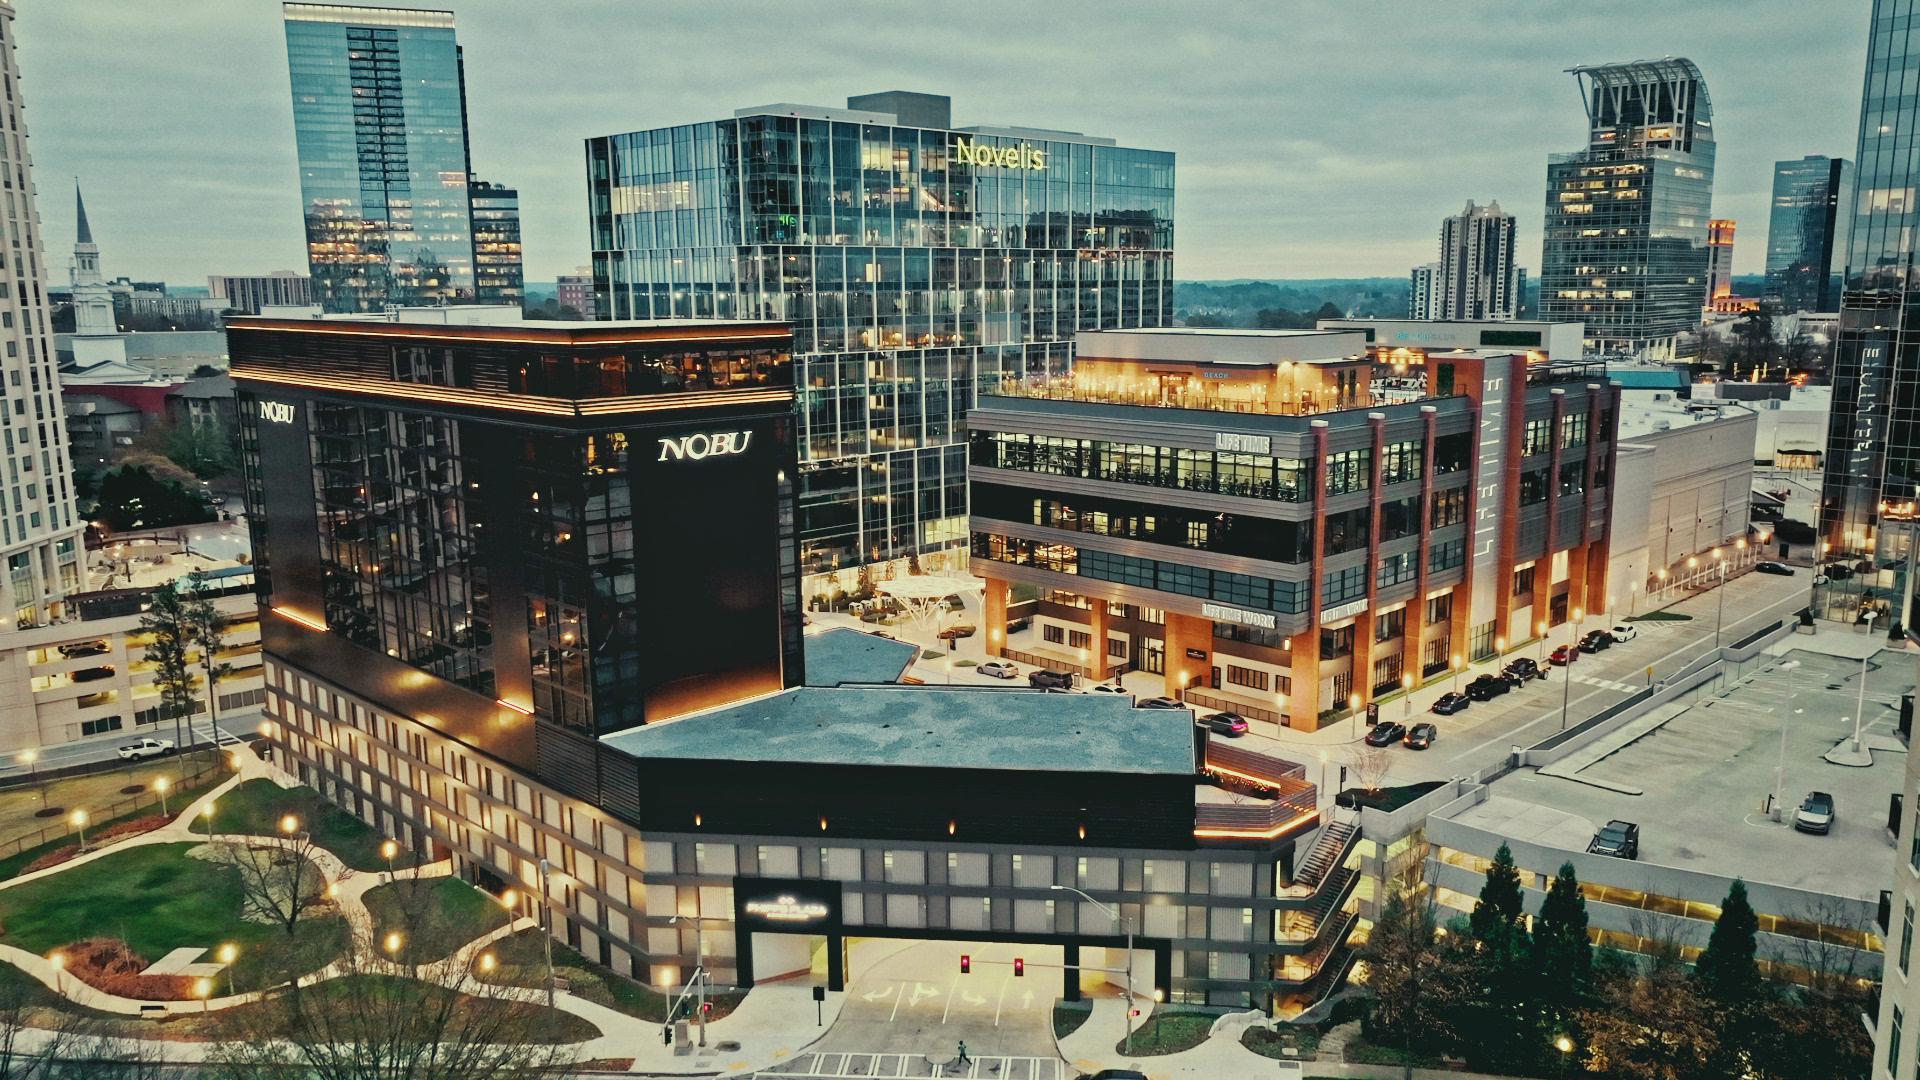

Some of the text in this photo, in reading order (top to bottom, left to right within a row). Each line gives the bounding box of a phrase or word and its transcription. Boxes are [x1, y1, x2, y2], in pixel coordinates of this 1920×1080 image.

[957, 136, 1044, 171] Novelis
[259, 400, 295, 424] NOBU
[657, 430, 753, 462] NOBU
[1242, 610, 1276, 630] WORK
